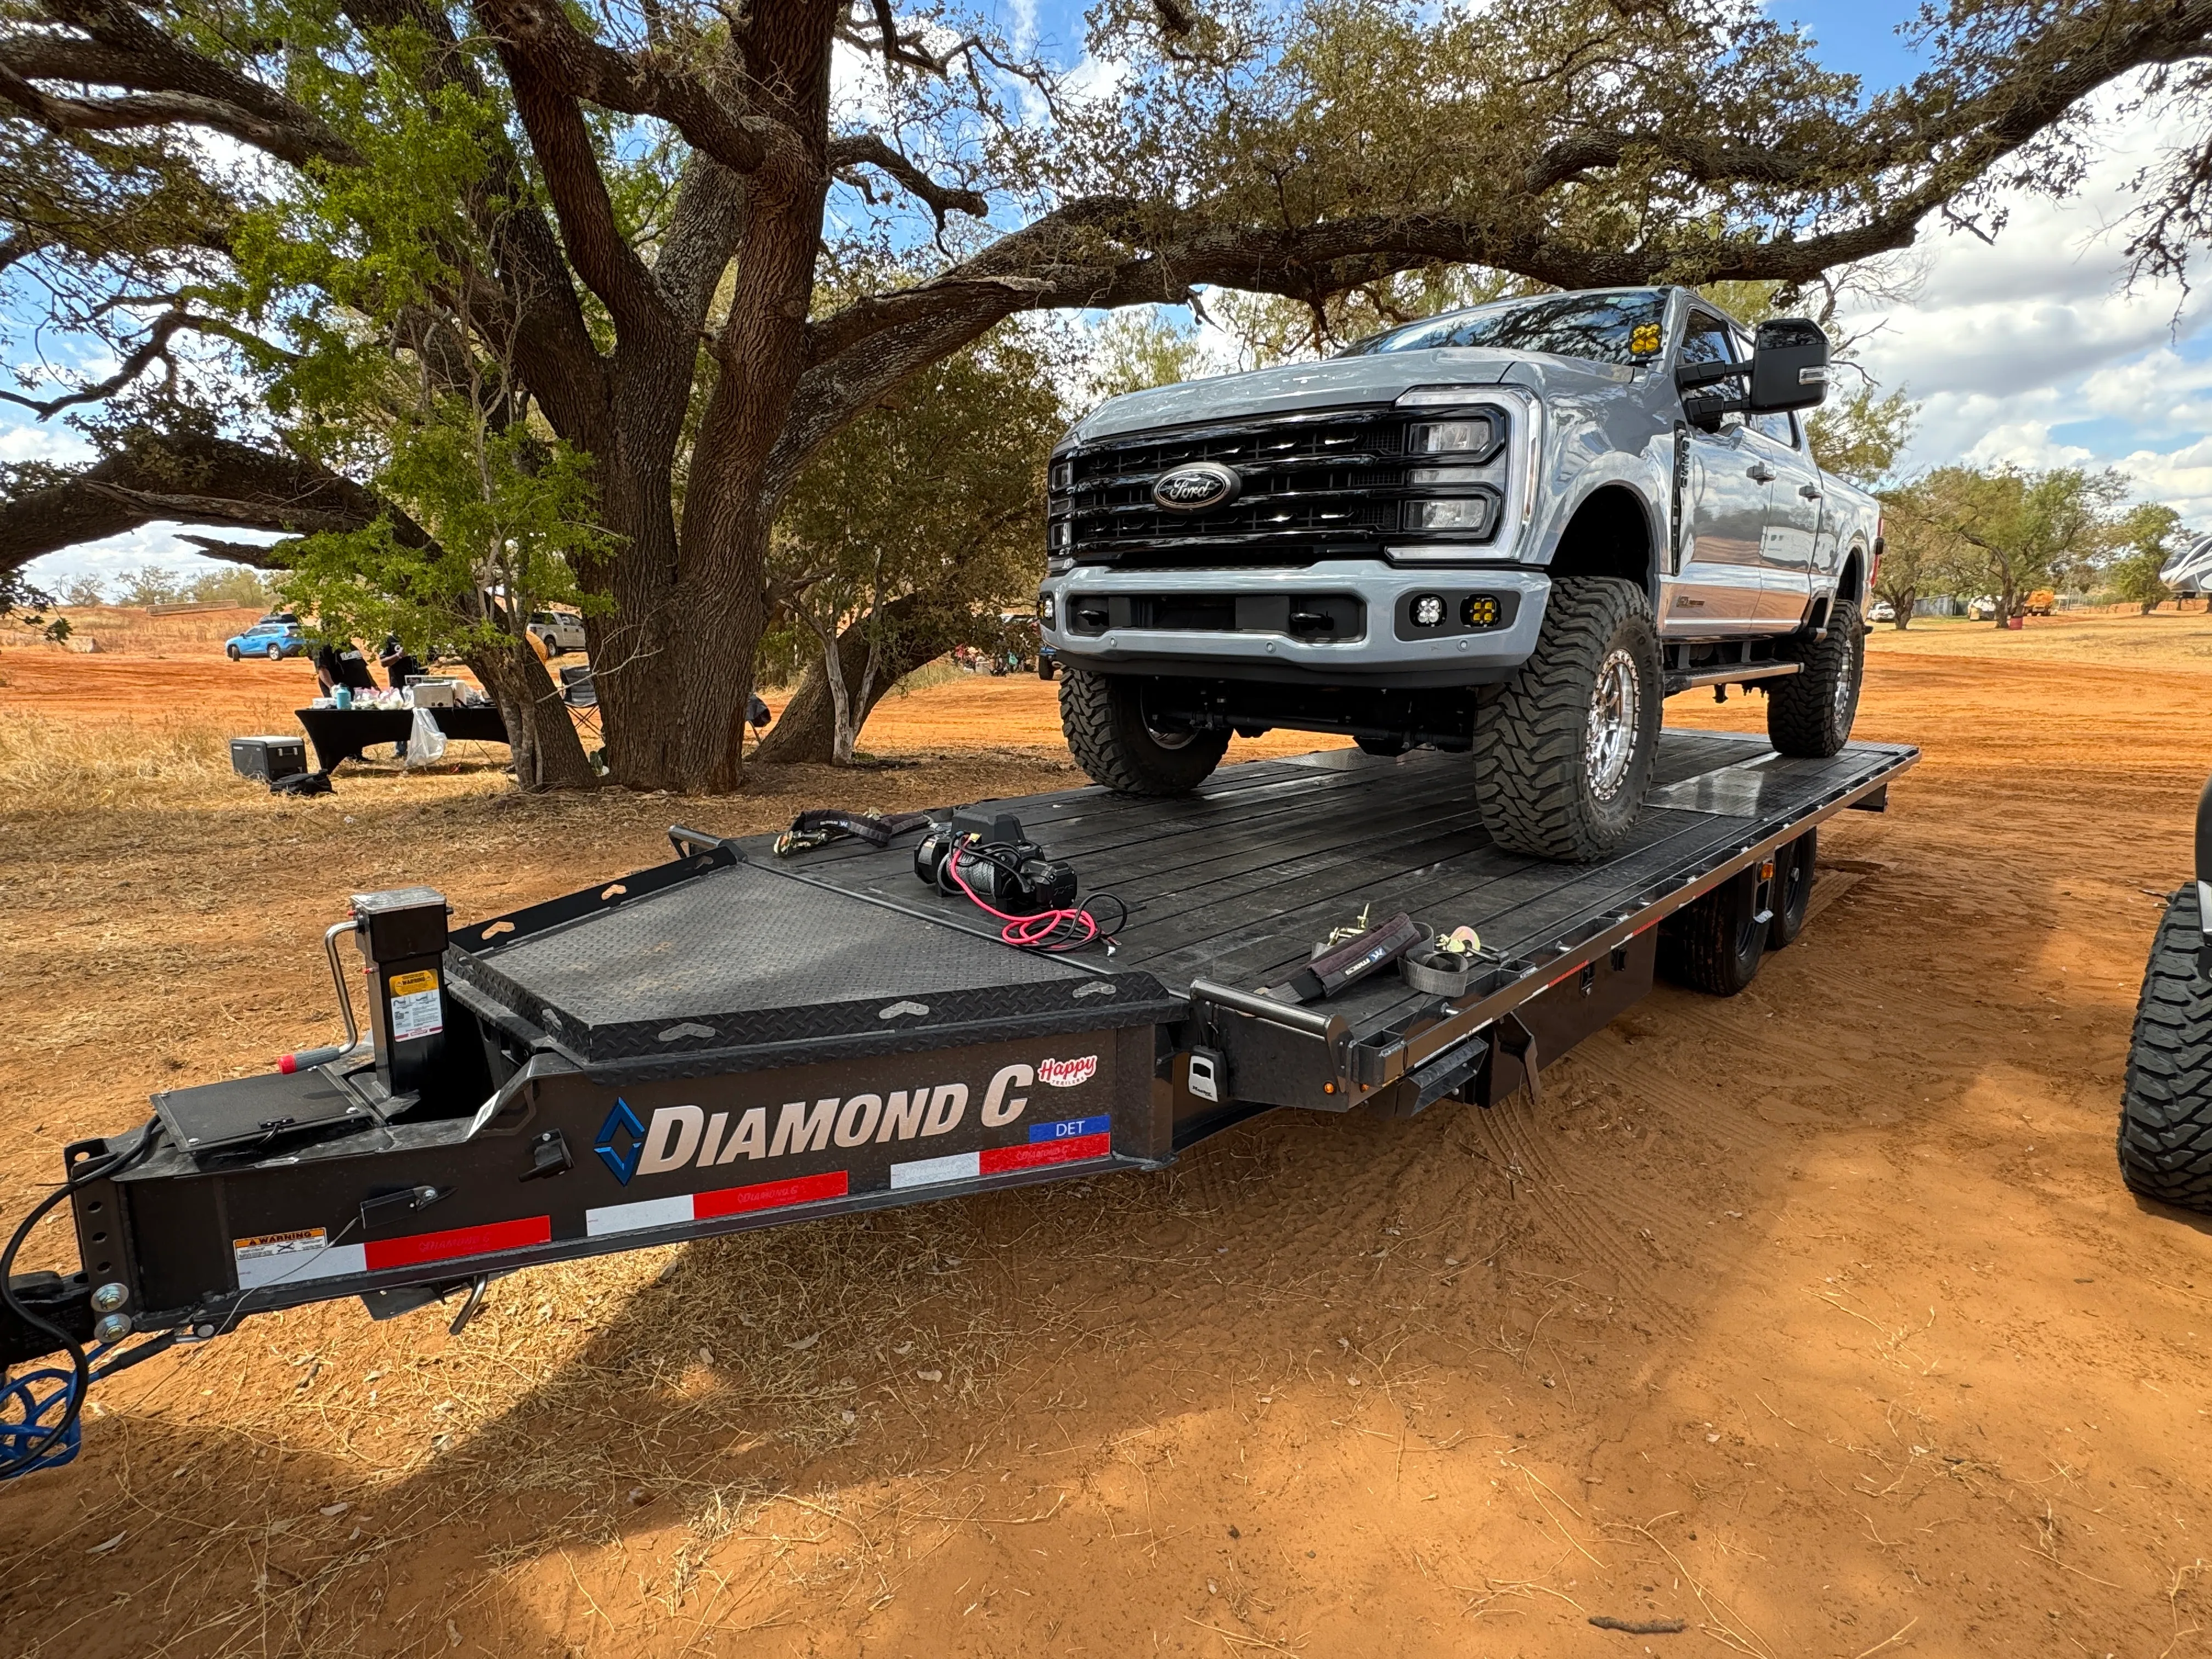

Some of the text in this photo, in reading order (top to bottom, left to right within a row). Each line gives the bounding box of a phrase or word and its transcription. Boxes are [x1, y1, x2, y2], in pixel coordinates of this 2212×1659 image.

[1170, 477, 1210, 500] Ford
[1040, 1057, 1095, 1081] Happy
[636, 1064, 1034, 1175] DIAMOND C
[1056, 1120, 1086, 1137] DET
[259, 1232, 312, 1244] WARNING
